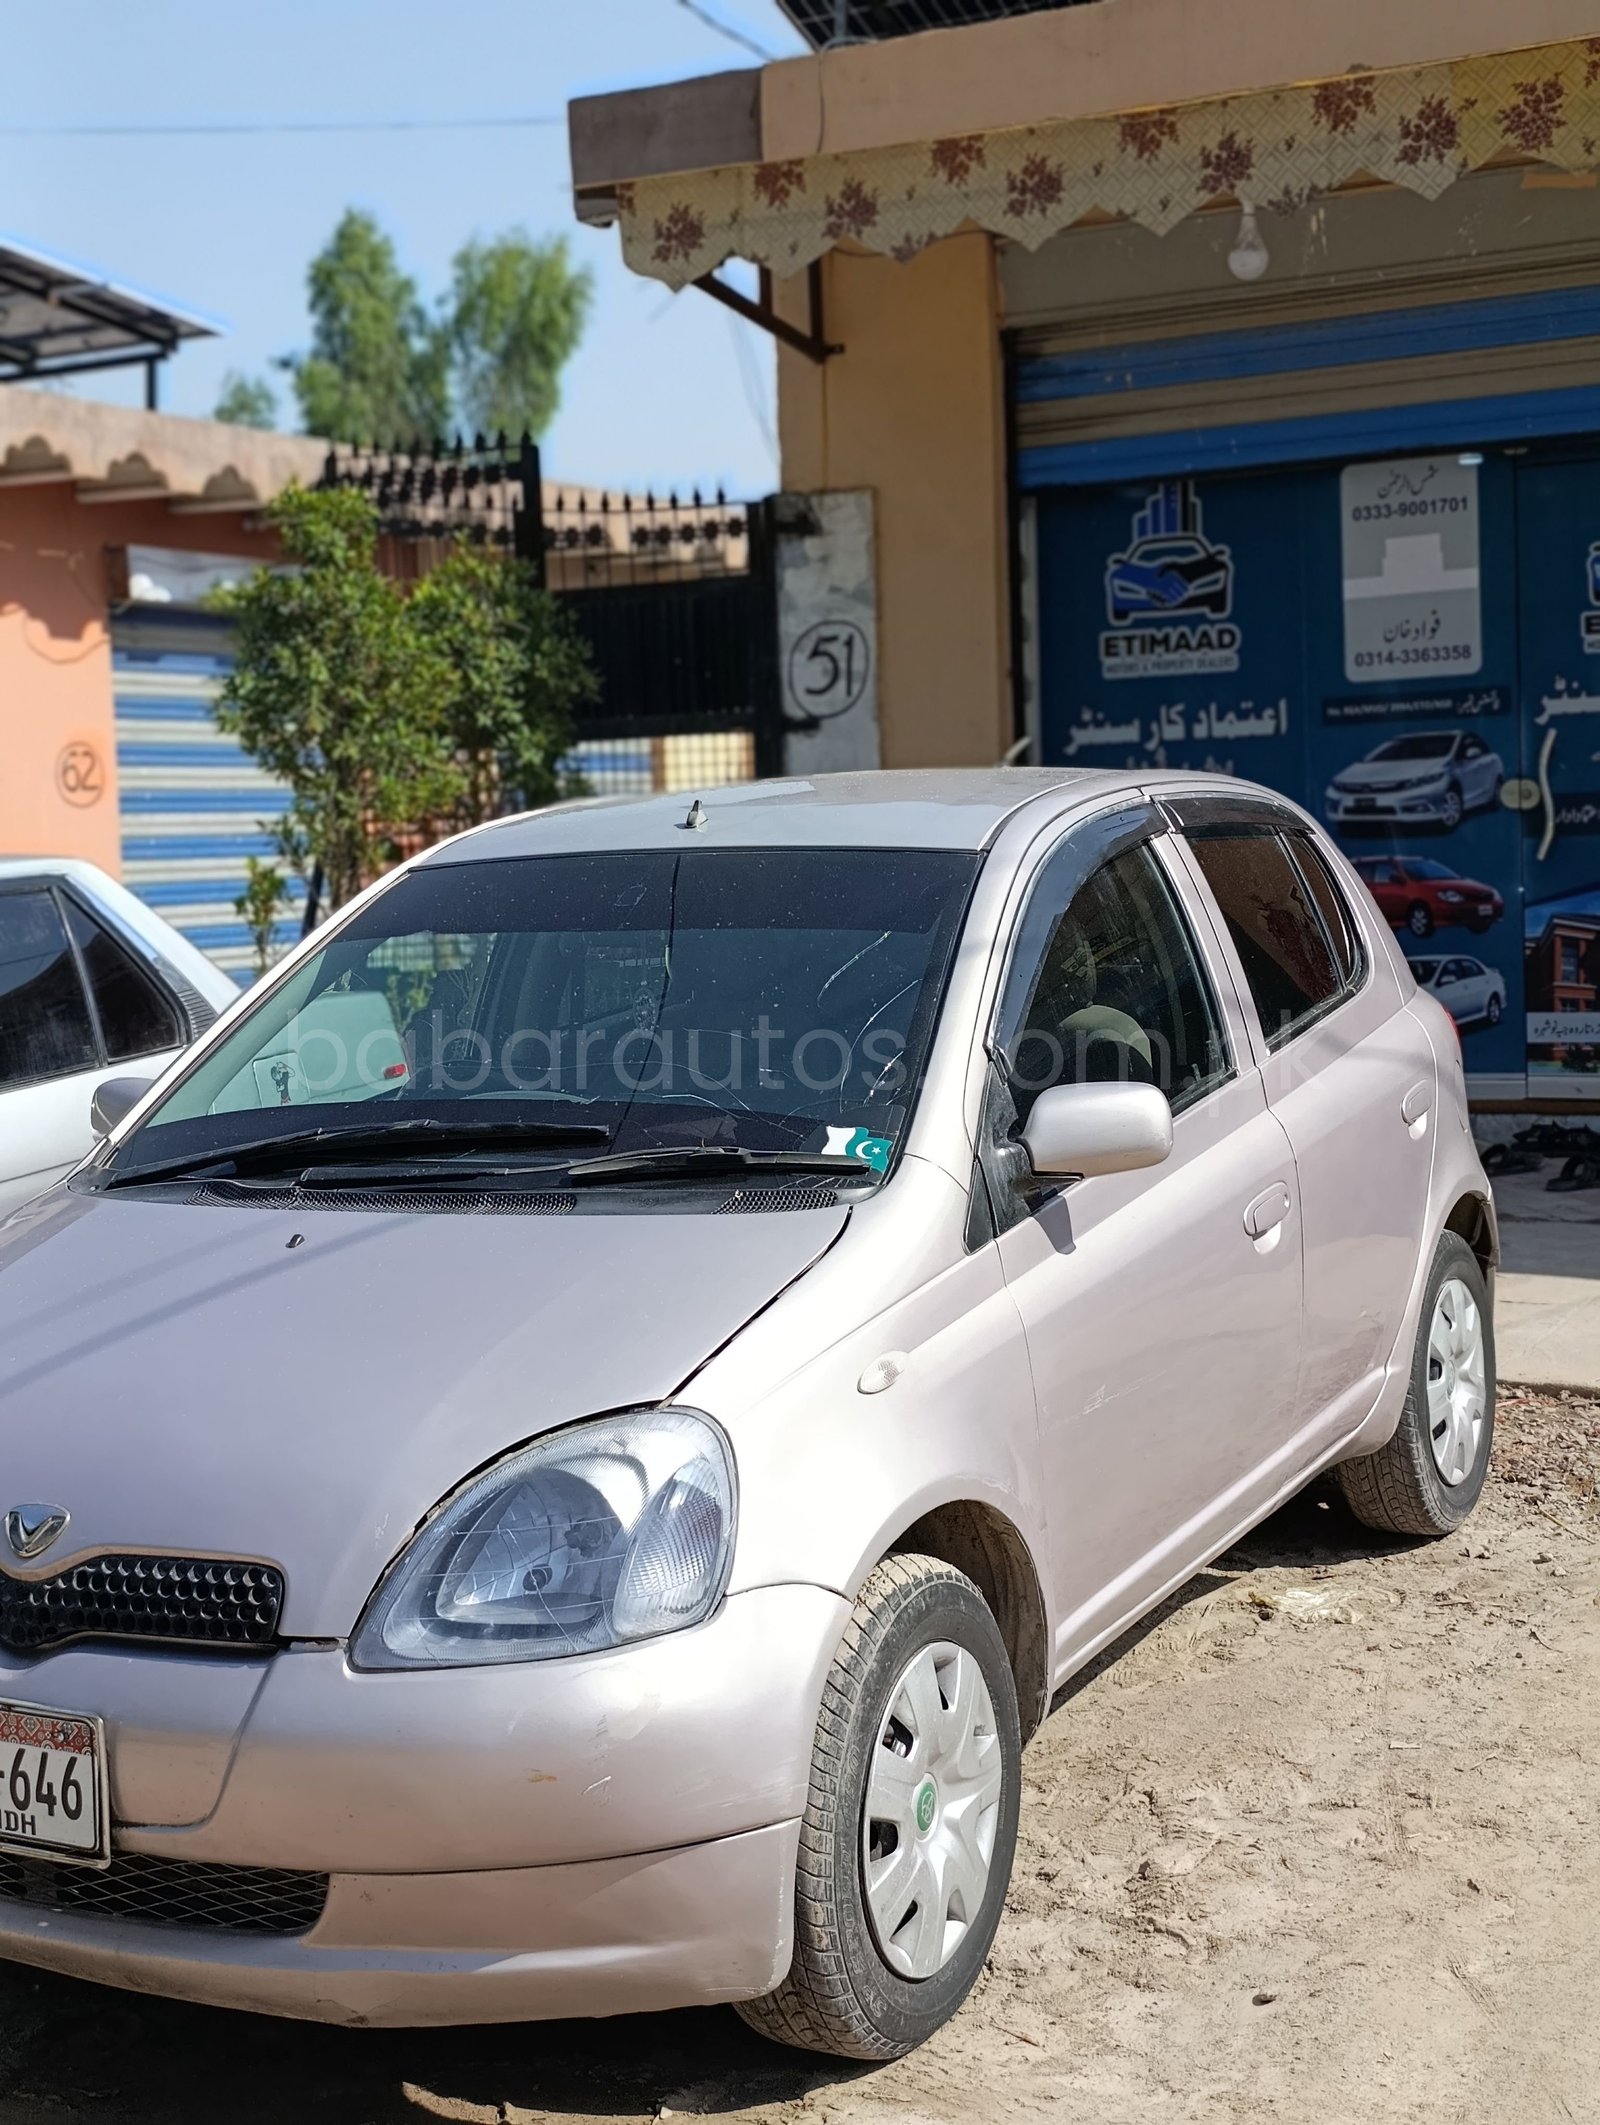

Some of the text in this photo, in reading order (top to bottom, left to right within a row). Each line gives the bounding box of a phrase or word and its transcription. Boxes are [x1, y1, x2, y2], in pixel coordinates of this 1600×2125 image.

[1352, 496, 1468, 522] 0333-9001701
[1103, 628, 1237, 658] ETIMAAD
[1354, 644, 1472, 668] 0314-3363358
[804, 633, 854, 698] 51
[1143, 703, 1187, 751] کار
[1191, 697, 1289, 740] اعتماد
[62, 750, 99, 793] 62
